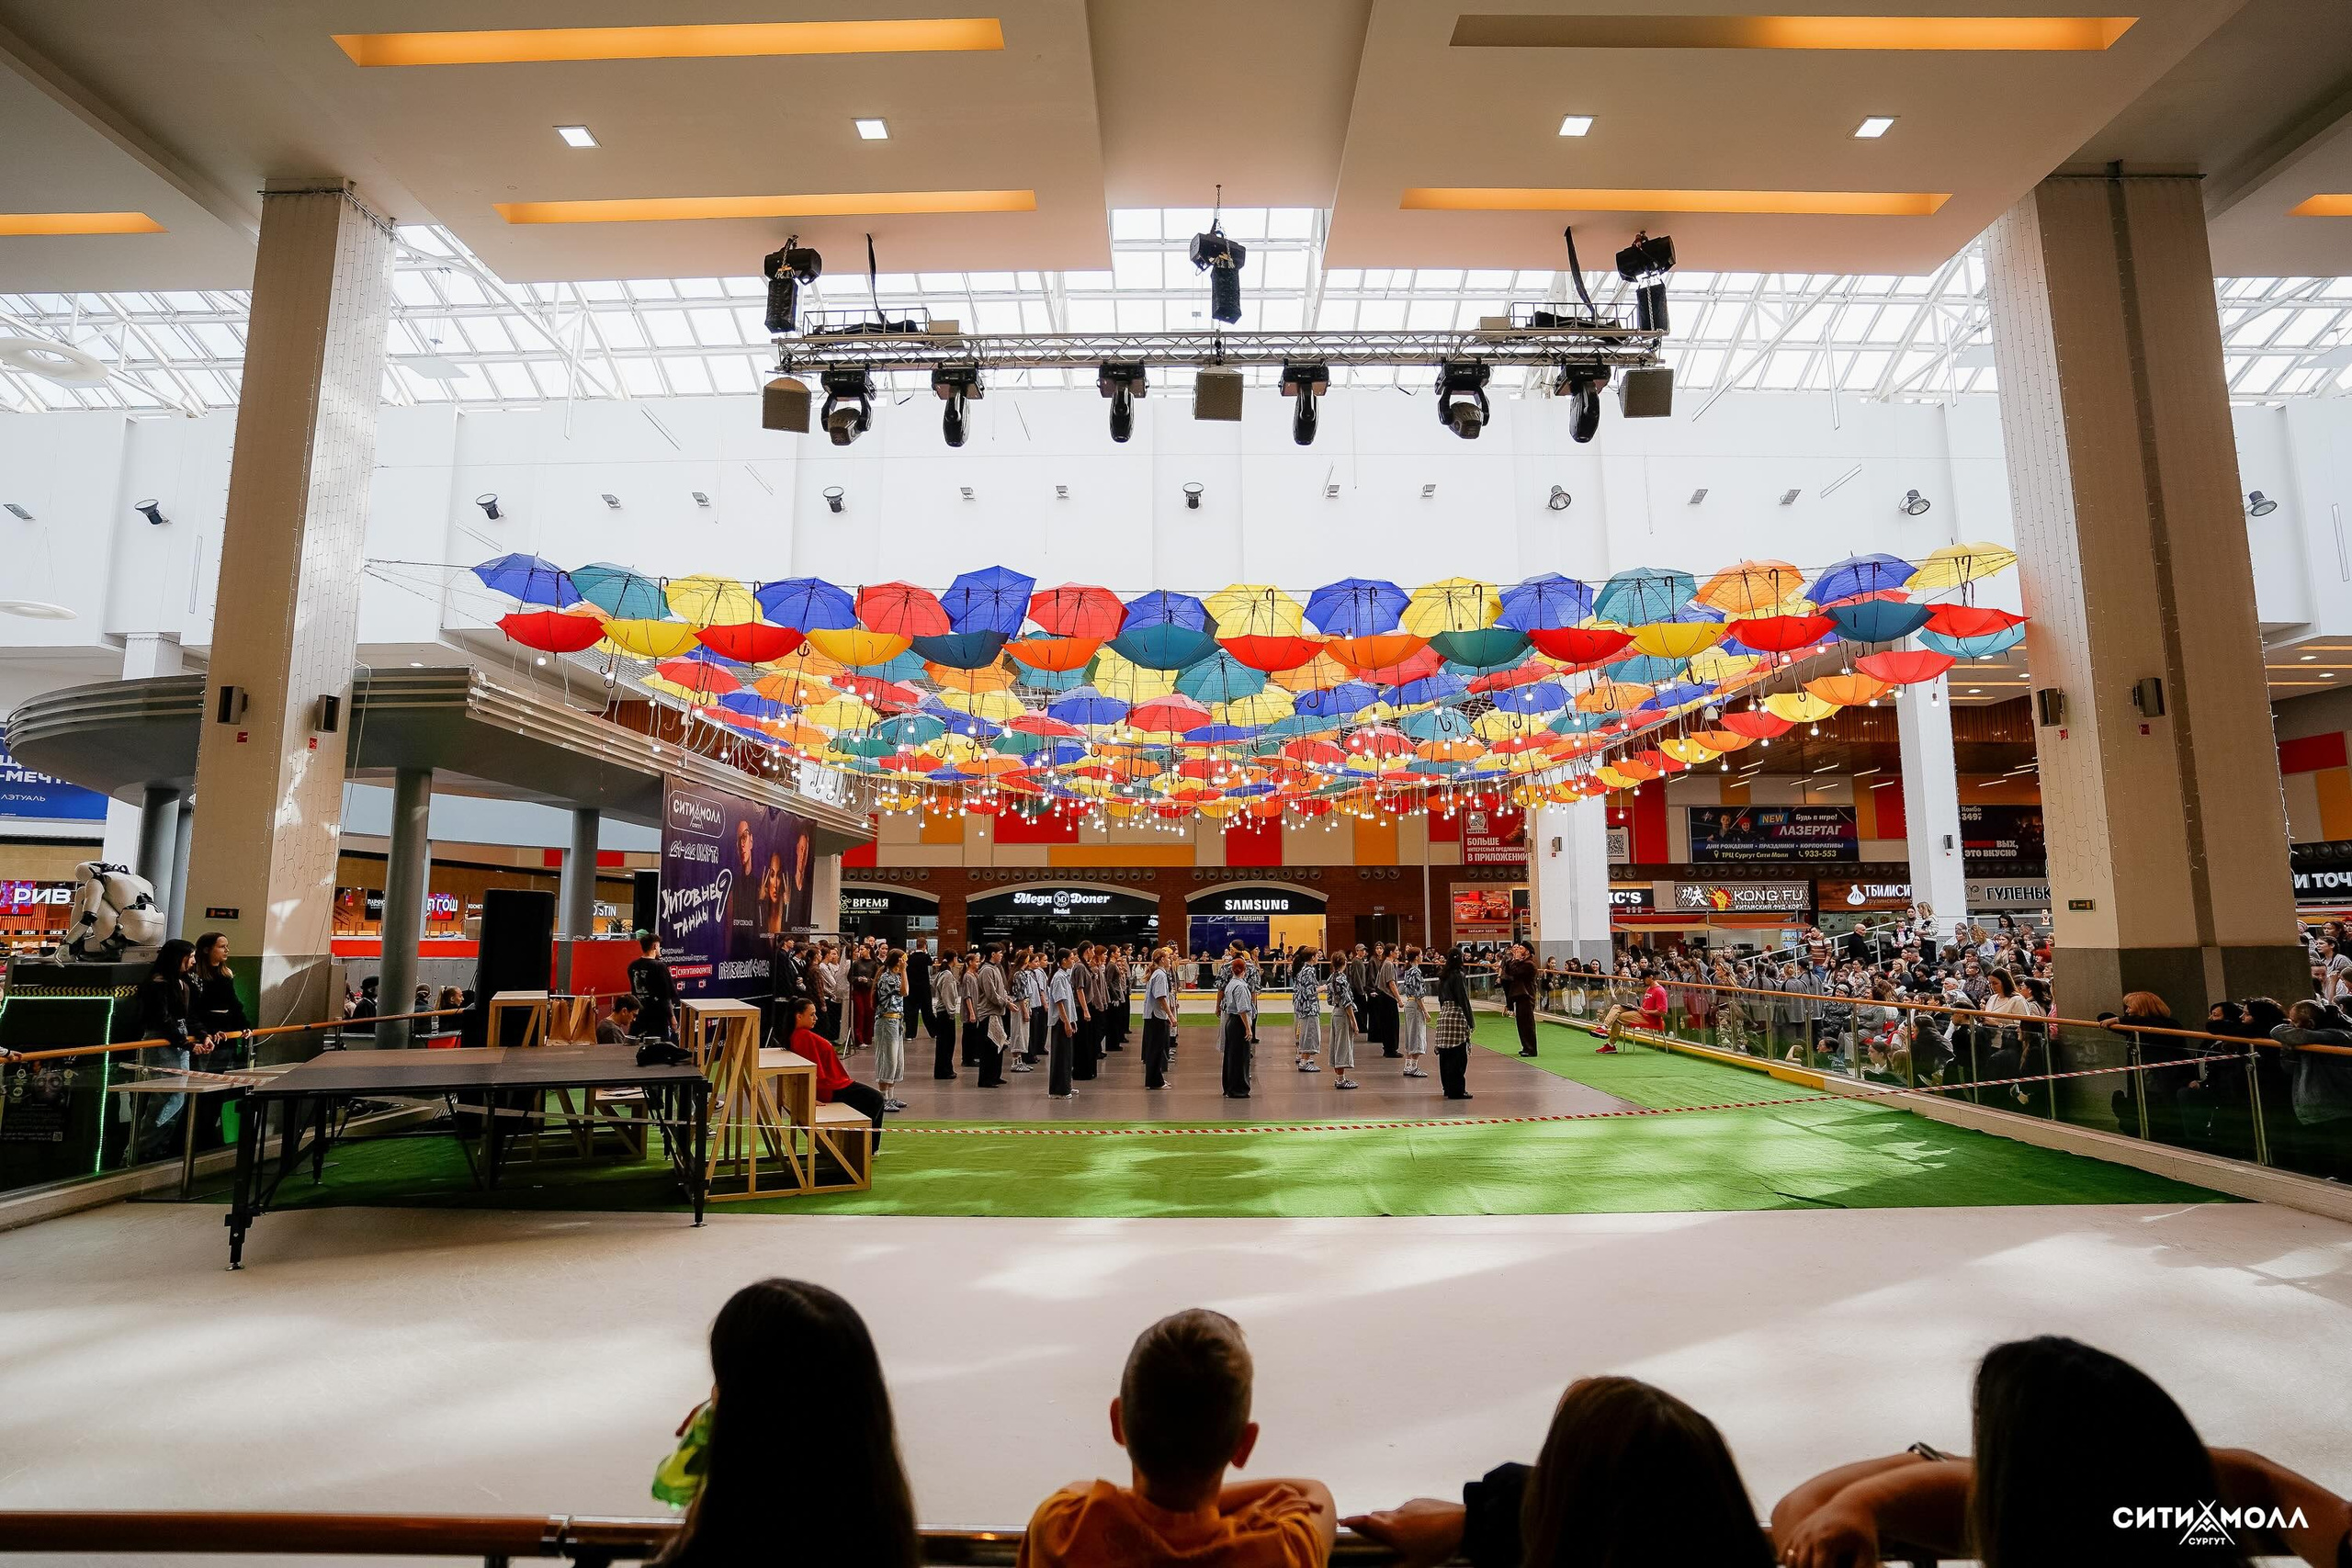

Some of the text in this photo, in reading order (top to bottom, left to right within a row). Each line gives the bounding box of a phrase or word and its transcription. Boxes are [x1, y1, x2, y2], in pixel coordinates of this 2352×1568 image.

[0, 771, 73, 784] -МЕЧ
[673, 799, 721, 824] СИТИ МОЛЛ
[1762, 815, 1784, 823] NEW
[1779, 826, 1842, 836] ЛАЗЕРТАГ
[1467, 838, 1499, 846] БОЛЬШЕ
[1467, 853, 1528, 862] В ПРИЛОЖЕНИИ
[14, 888, 71, 904] РИВ
[1735, 890, 1803, 901] KONG FU
[1863, 885, 1912, 897] ТБИЛИСИ
[662, 884, 717, 922] ХИТОВЫЕ
[853, 898, 888, 908] ВРЕМЯ
[1013, 893, 1052, 906] Mega
[1070, 893, 1110, 904] Doner
[1225, 899, 1289, 910] SAMSUNG
[673, 906, 709, 938] ТАНЦЫ
